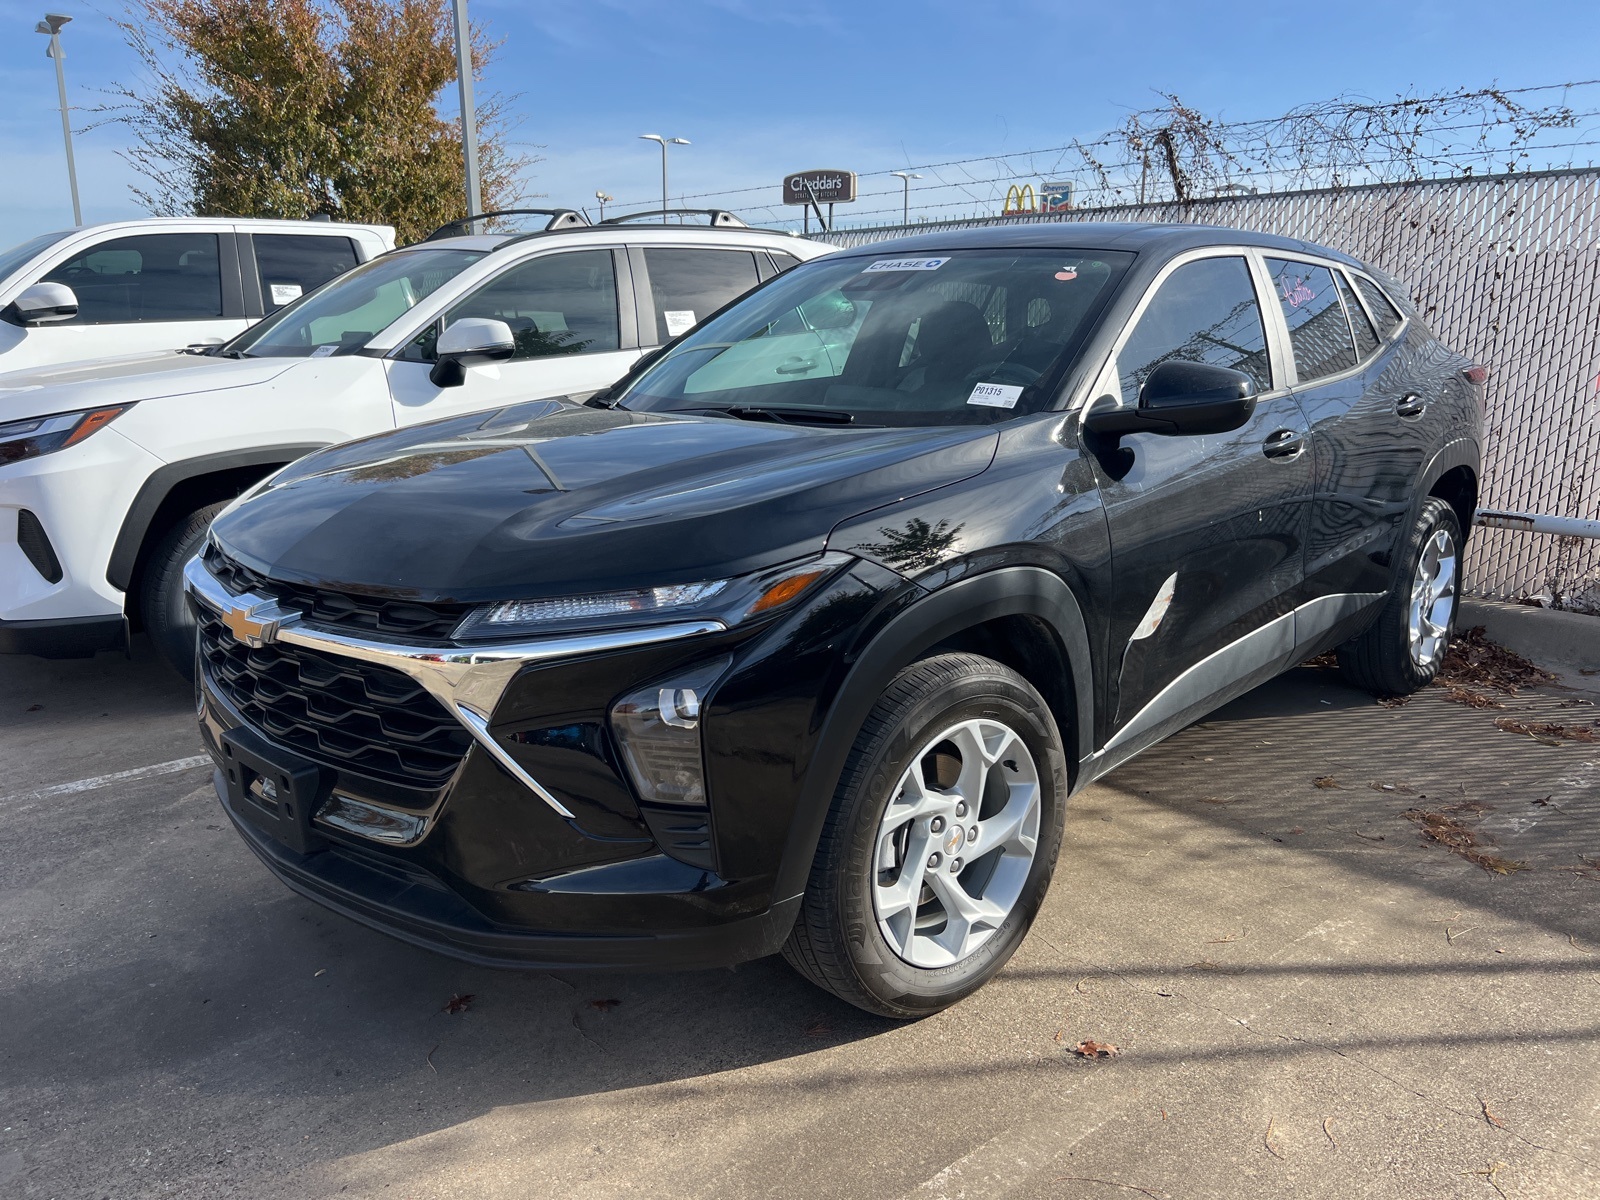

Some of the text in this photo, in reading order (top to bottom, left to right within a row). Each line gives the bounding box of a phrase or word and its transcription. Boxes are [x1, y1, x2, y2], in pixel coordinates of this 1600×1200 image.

[790, 175, 842, 191] Cheddar's
[870, 261, 924, 269] CHASE
[974, 386, 1003, 396] P01315
